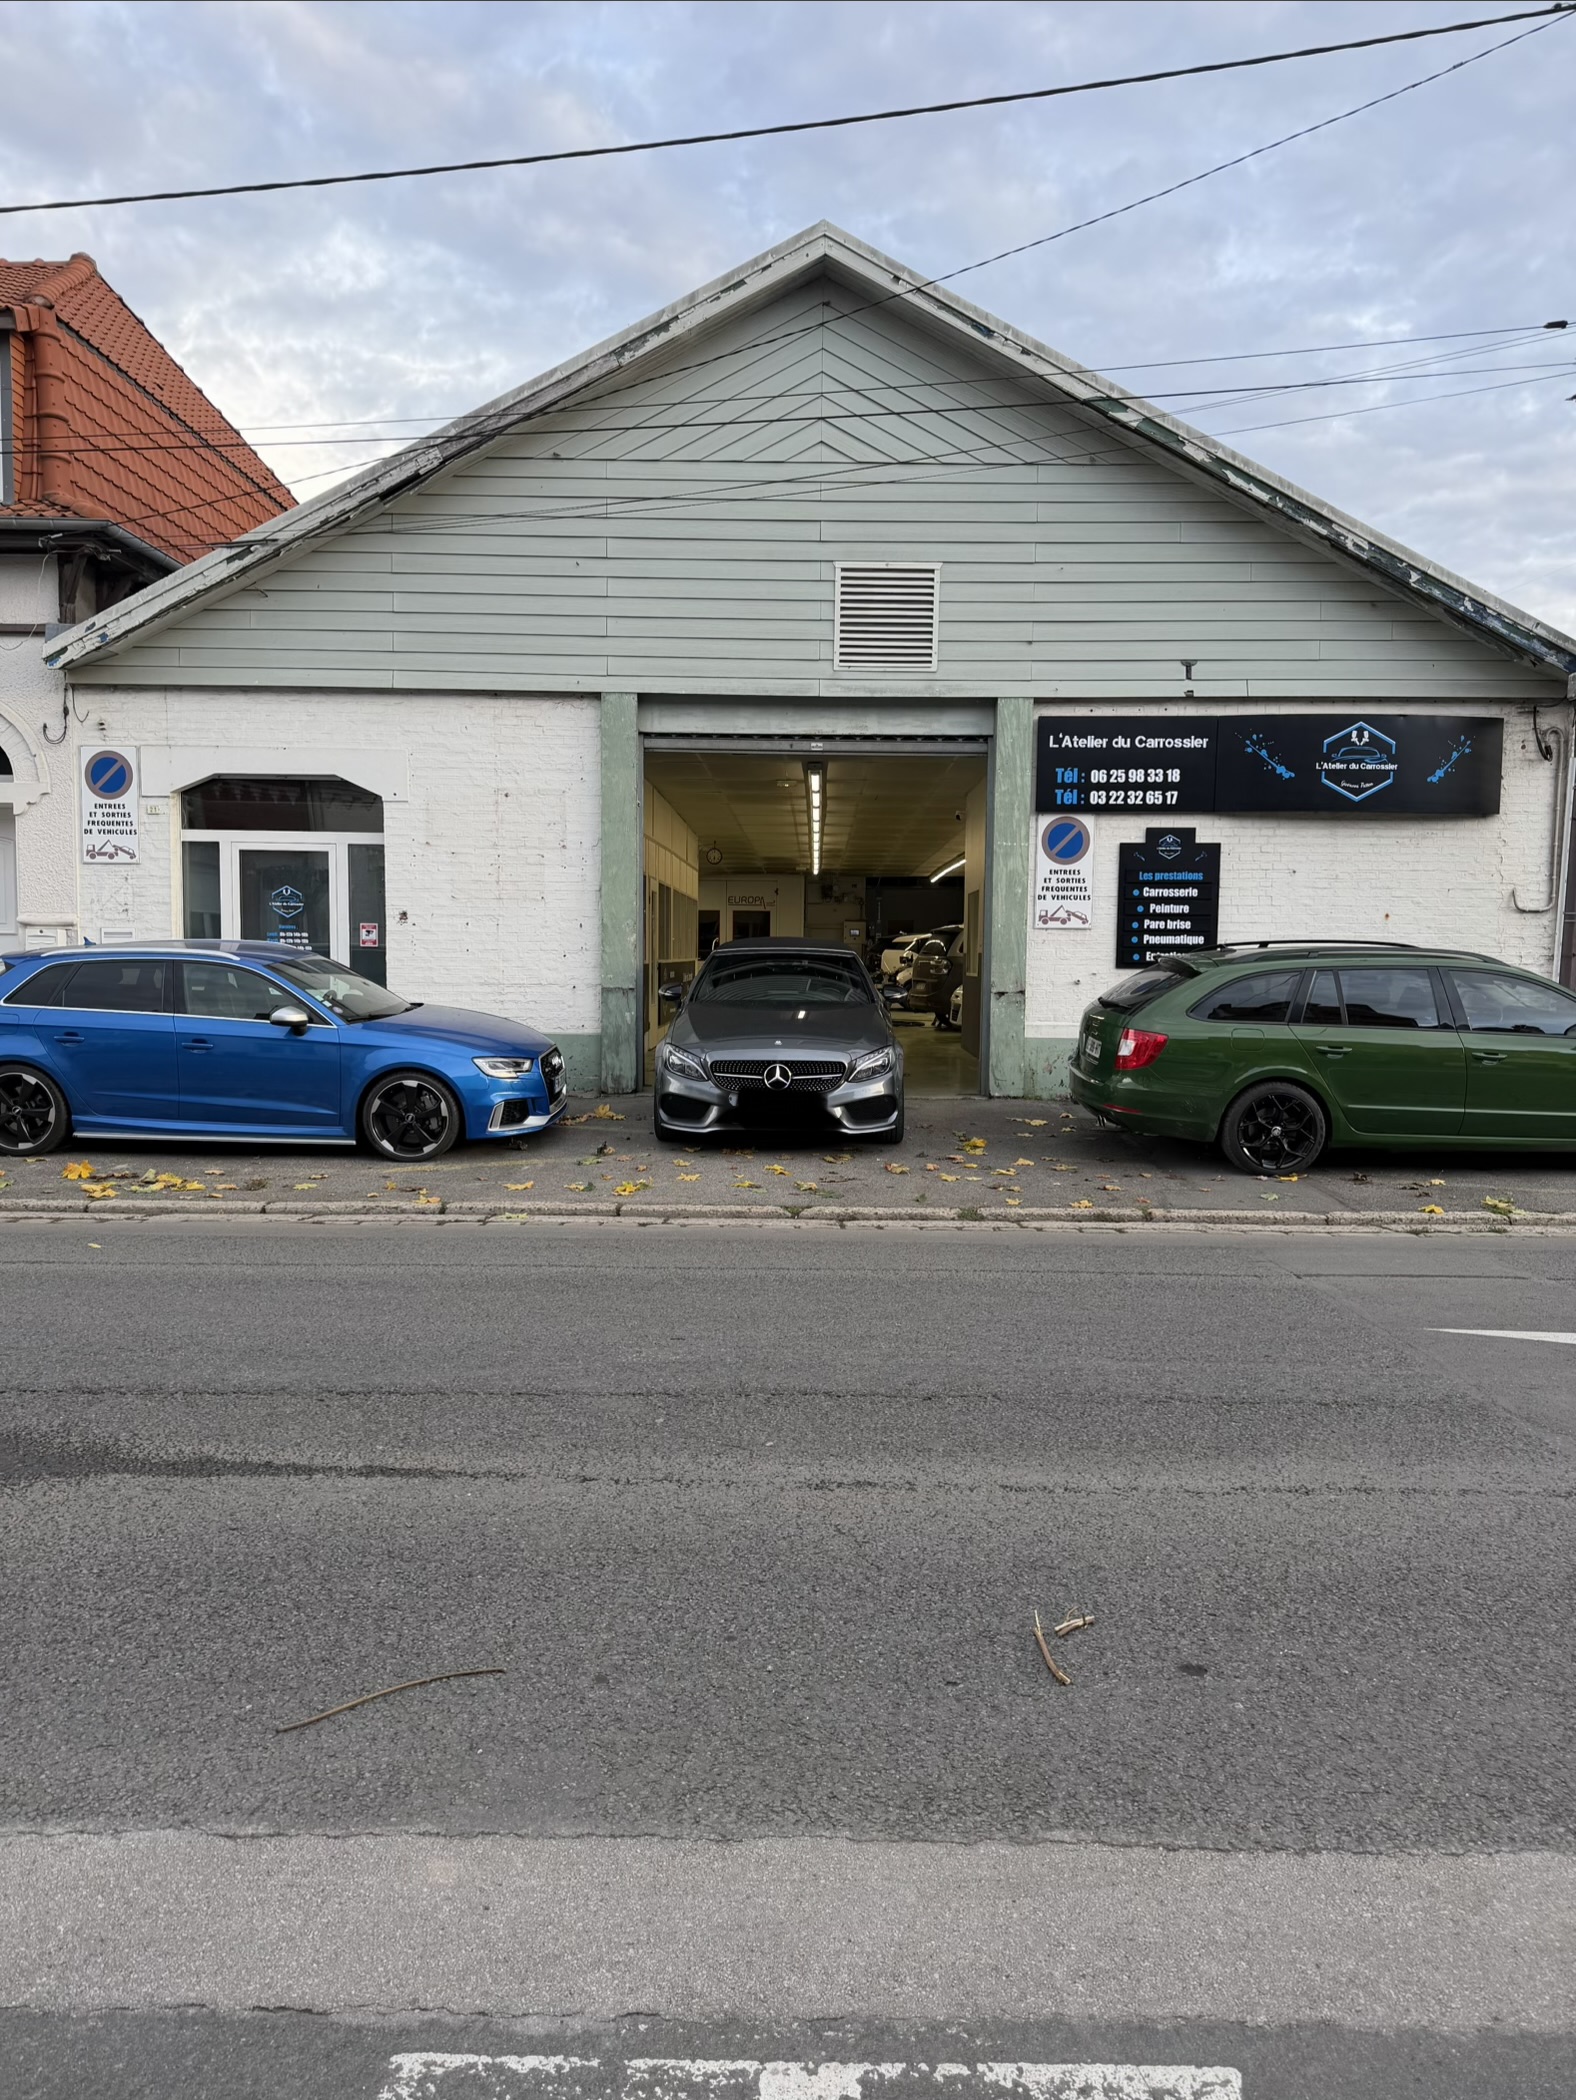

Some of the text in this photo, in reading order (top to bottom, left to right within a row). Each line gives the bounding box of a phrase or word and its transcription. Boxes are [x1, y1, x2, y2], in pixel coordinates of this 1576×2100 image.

[1049, 732, 1209, 748] L'Atelier du Carrossier
[1315, 761, 1398, 770] L'Atelier du Carrossier
[1090, 769, 1107, 783] 06
[1109, 769, 1126, 783] 25
[1128, 769, 1145, 783] 98
[1147, 769, 1164, 783] 33
[1166, 769, 1181, 783] 18
[1089, 790, 1107, 805] 03
[1108, 790, 1125, 805] 22
[1127, 790, 1143, 805] 32
[1145, 790, 1163, 805] 65
[1165, 790, 1178, 805] 17
[101, 811, 132, 819] SORTIES
[1139, 871, 1204, 882] Les prestations
[1041, 885, 1088, 893] FREQUENTES
[1142, 886, 1199, 897] Carrosserie
[1149, 903, 1190, 914] Peinture
[1143, 918, 1192, 930] Pare brise
[1142, 934, 1205, 946] Pneumatique
